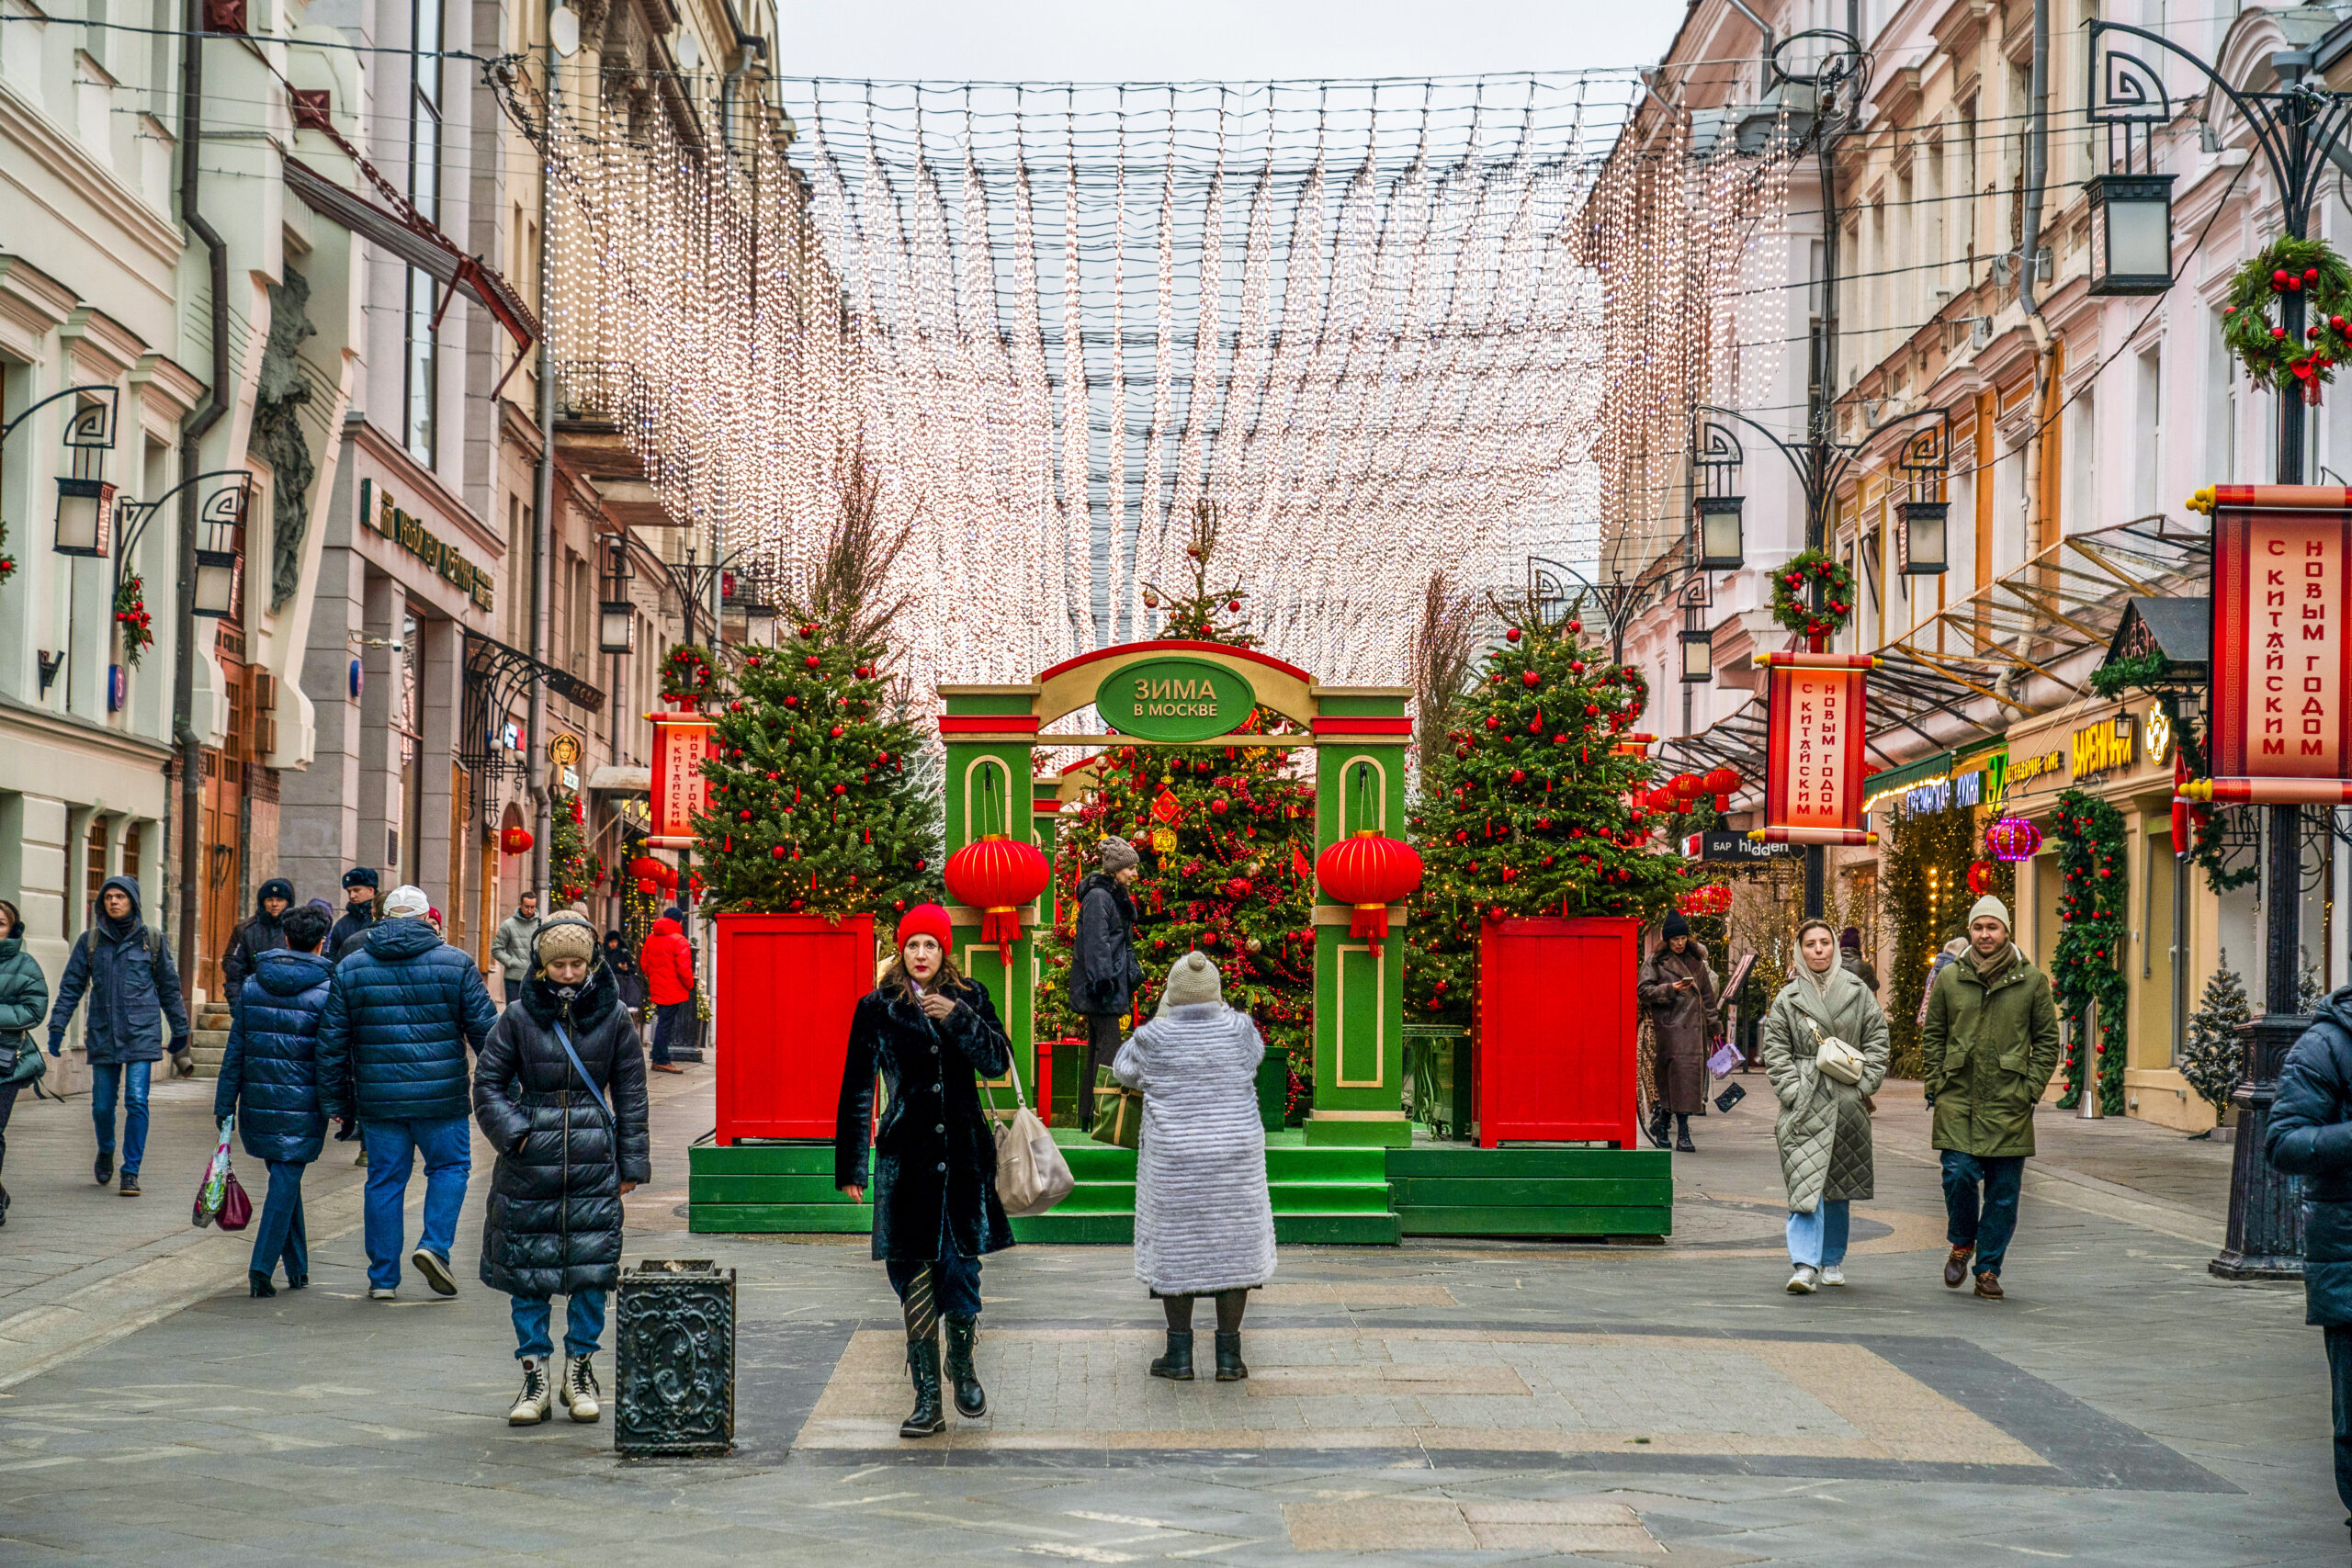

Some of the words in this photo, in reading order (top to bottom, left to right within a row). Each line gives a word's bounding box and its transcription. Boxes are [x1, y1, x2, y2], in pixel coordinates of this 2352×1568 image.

[2267, 540, 2285, 556] С
[2302, 540, 2324, 640] НОВЫМ
[2262, 570, 2285, 755] КИТАЙСКИМ
[1134, 678, 1217, 701] ЗИМА
[1134, 704, 1143, 716] В
[1148, 704, 1218, 716] МОСКВЕ
[1802, 683, 1813, 694] С
[2301, 656, 2324, 756] ГОДОМ
[674, 733, 682, 741] С
[1822, 684, 1836, 746] НОВЫМ
[688, 734, 698, 778] НОВЫМ
[1796, 701, 1812, 815] КИТАЙСКИМ
[671, 747, 682, 828] КИТАЙСКИМ
[1819, 754, 1834, 816] ГОДОМ
[1956, 771, 1979, 809] КУХНЯ
[1713, 842, 1732, 851] БАР
[1739, 838, 1789, 856] hidden
